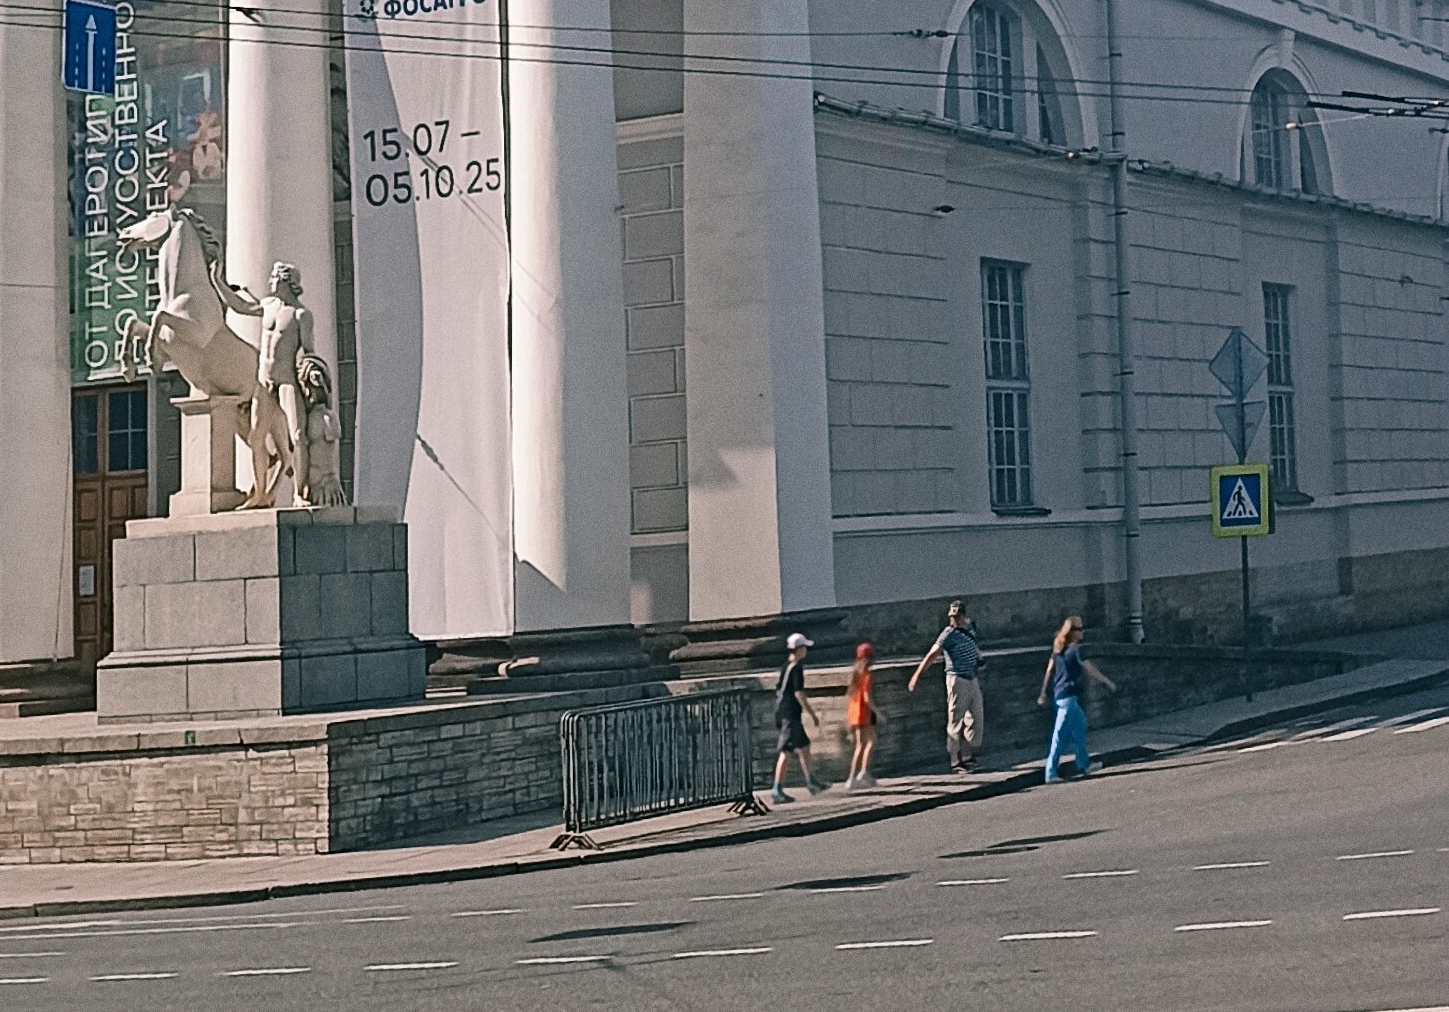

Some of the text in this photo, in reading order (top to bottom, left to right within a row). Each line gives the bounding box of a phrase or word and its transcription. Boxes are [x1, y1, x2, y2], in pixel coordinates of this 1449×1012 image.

[363, 120, 450, 162] 15.07
[365, 158, 502, 207] 05.10.25
[85, 94, 112, 368] ОТ ДАГЕРОТИП
